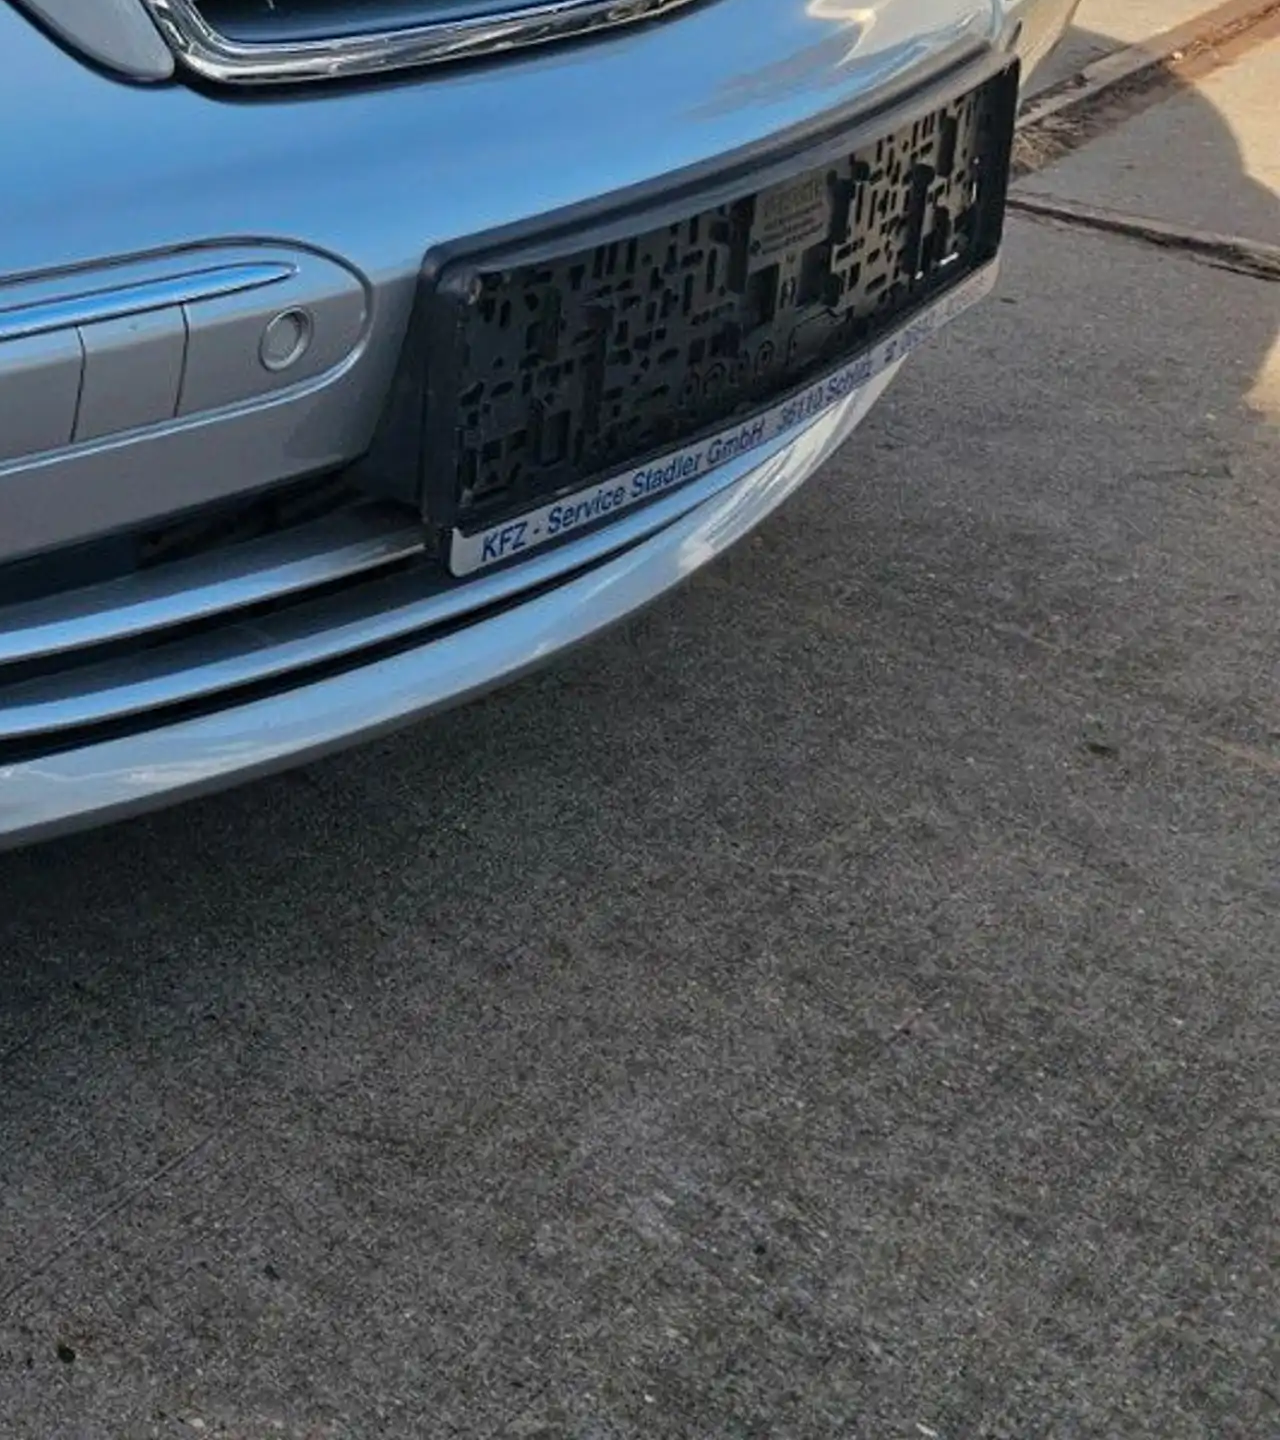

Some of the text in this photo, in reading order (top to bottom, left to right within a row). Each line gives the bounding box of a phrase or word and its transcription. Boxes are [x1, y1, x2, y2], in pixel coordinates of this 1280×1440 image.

[481, 521, 528, 561] KFZ
[548, 486, 626, 535] Service
[632, 452, 705, 497] Stadler
[707, 419, 766, 465] GmbH
